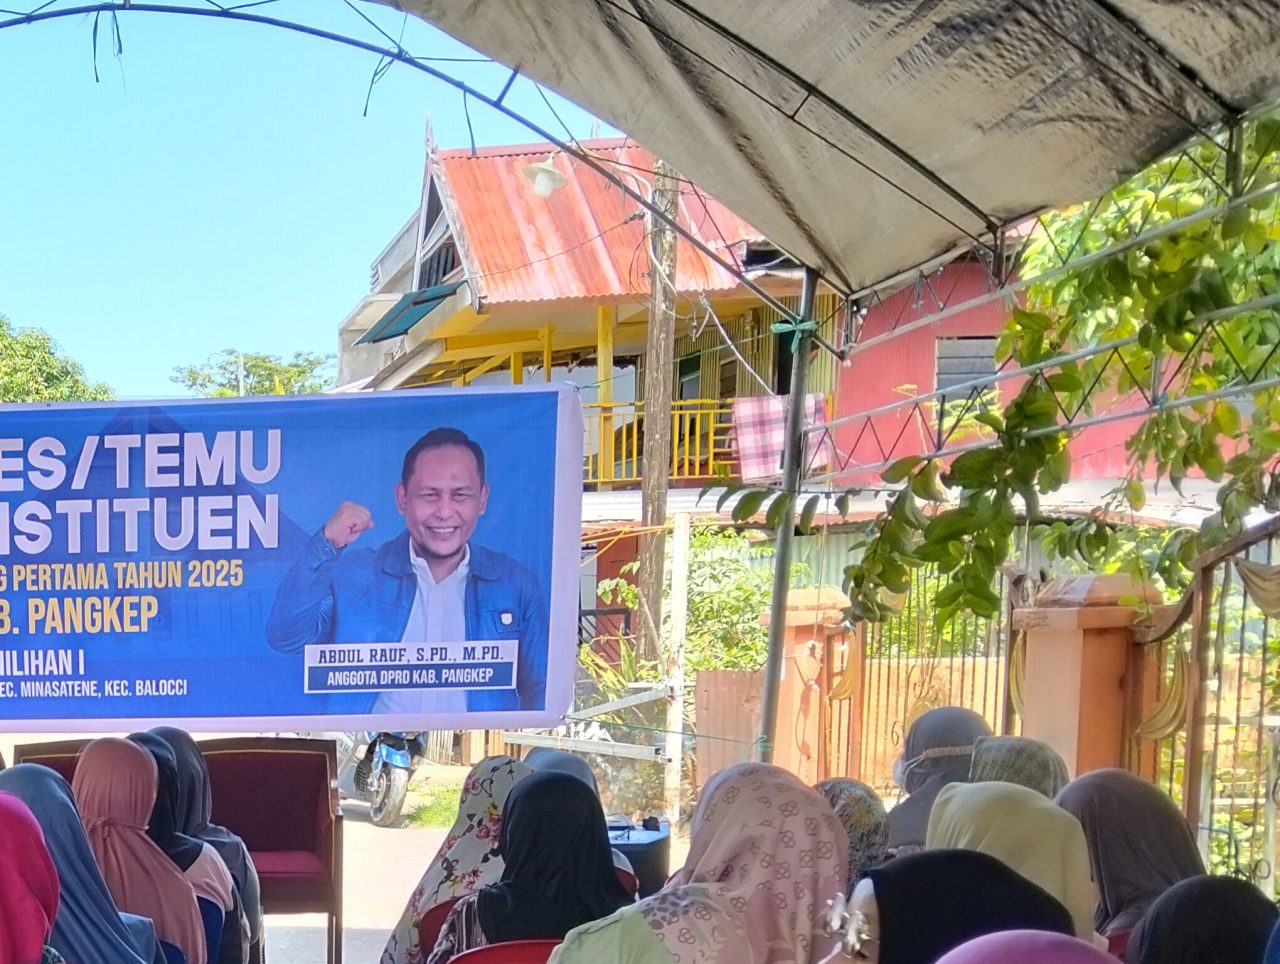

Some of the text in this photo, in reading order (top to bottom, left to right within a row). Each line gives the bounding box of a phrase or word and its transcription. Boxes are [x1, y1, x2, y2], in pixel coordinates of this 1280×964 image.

[13, 562, 109, 591] PERTAMA
[113, 561, 183, 589] TAHUN
[187, 559, 244, 588] 2025
[27, 595, 159, 635] PANGKEP
[78, 649, 85, 675] I
[318, 645, 505, 665] ABDUL RAUF, S.PD., M.PD.
[20, 679, 102, 699] MINASATENE,
[104, 680, 133, 697] KEC.
[135, 678, 188, 696] BALOCCI
[327, 667, 494, 687] ANGGOTA DPRD KAB. PANGKEP
